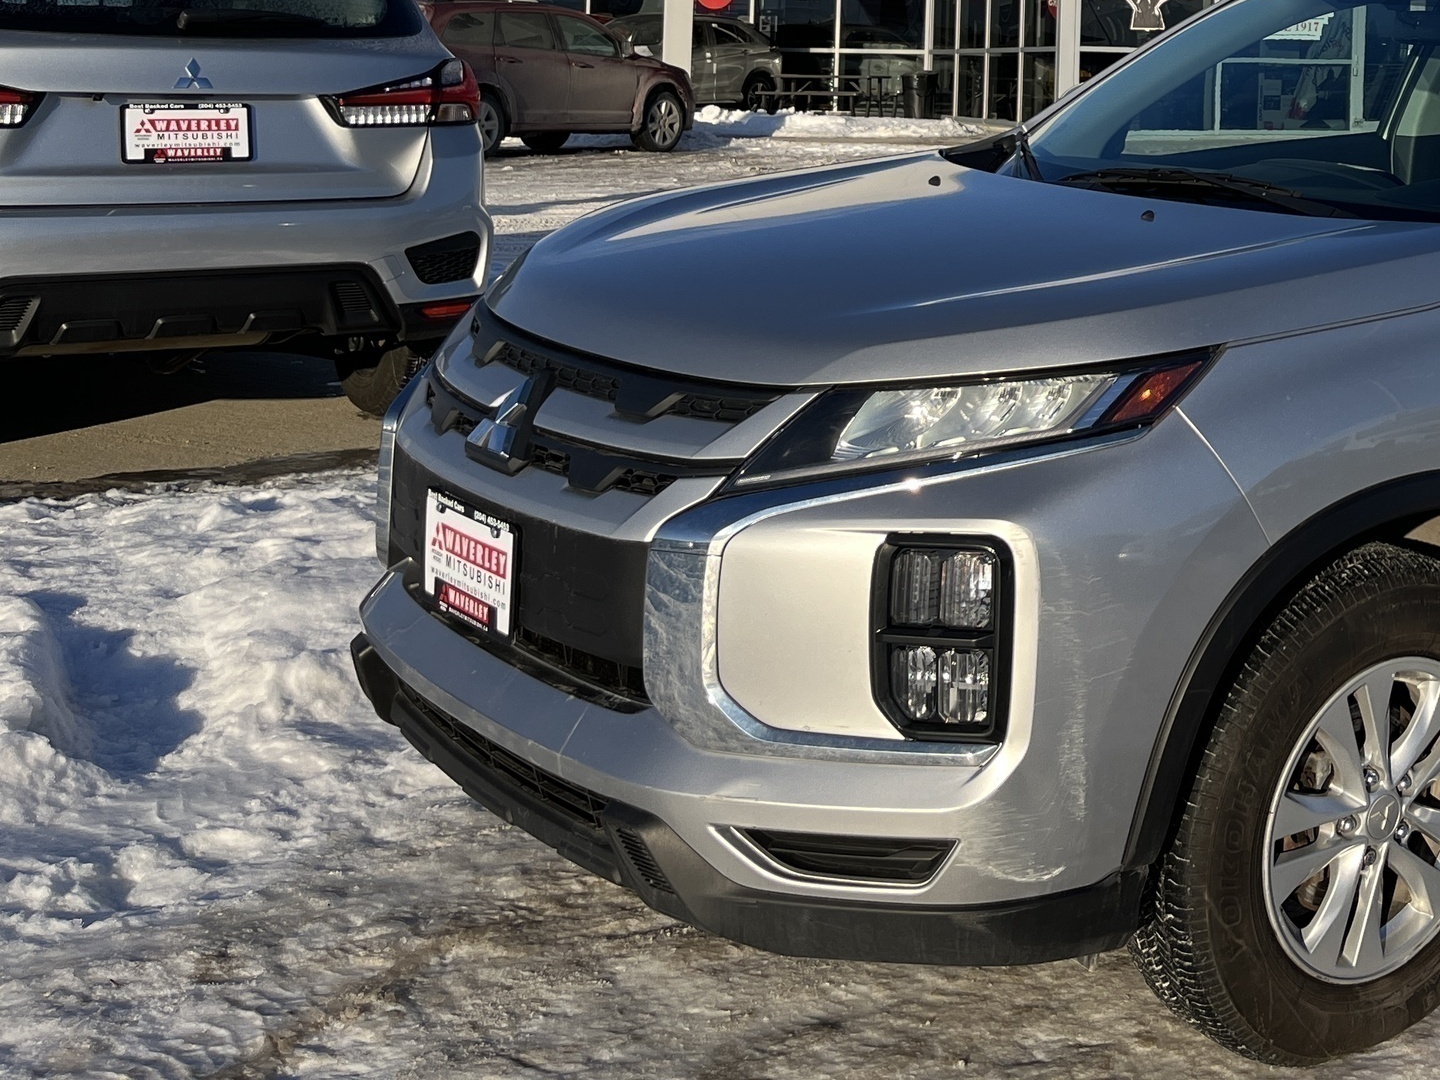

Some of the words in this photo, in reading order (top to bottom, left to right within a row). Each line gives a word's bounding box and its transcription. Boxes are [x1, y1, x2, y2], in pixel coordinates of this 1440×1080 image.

[154, 119, 238, 131] WAVERLEY
[157, 132, 238, 140] MITSUBISHI
[135, 141, 240, 149] waverleymitsubishi.com
[167, 148, 221, 157] WAVERLEY
[445, 527, 506, 575] WAVERLEY
[431, 566, 507, 610] waverleymitsubishi.com
[445, 553, 506, 595] MITSUBISHI
[448, 587, 488, 621] WAVERLEY
[1219, 669, 1314, 962] YOKOHAMA
